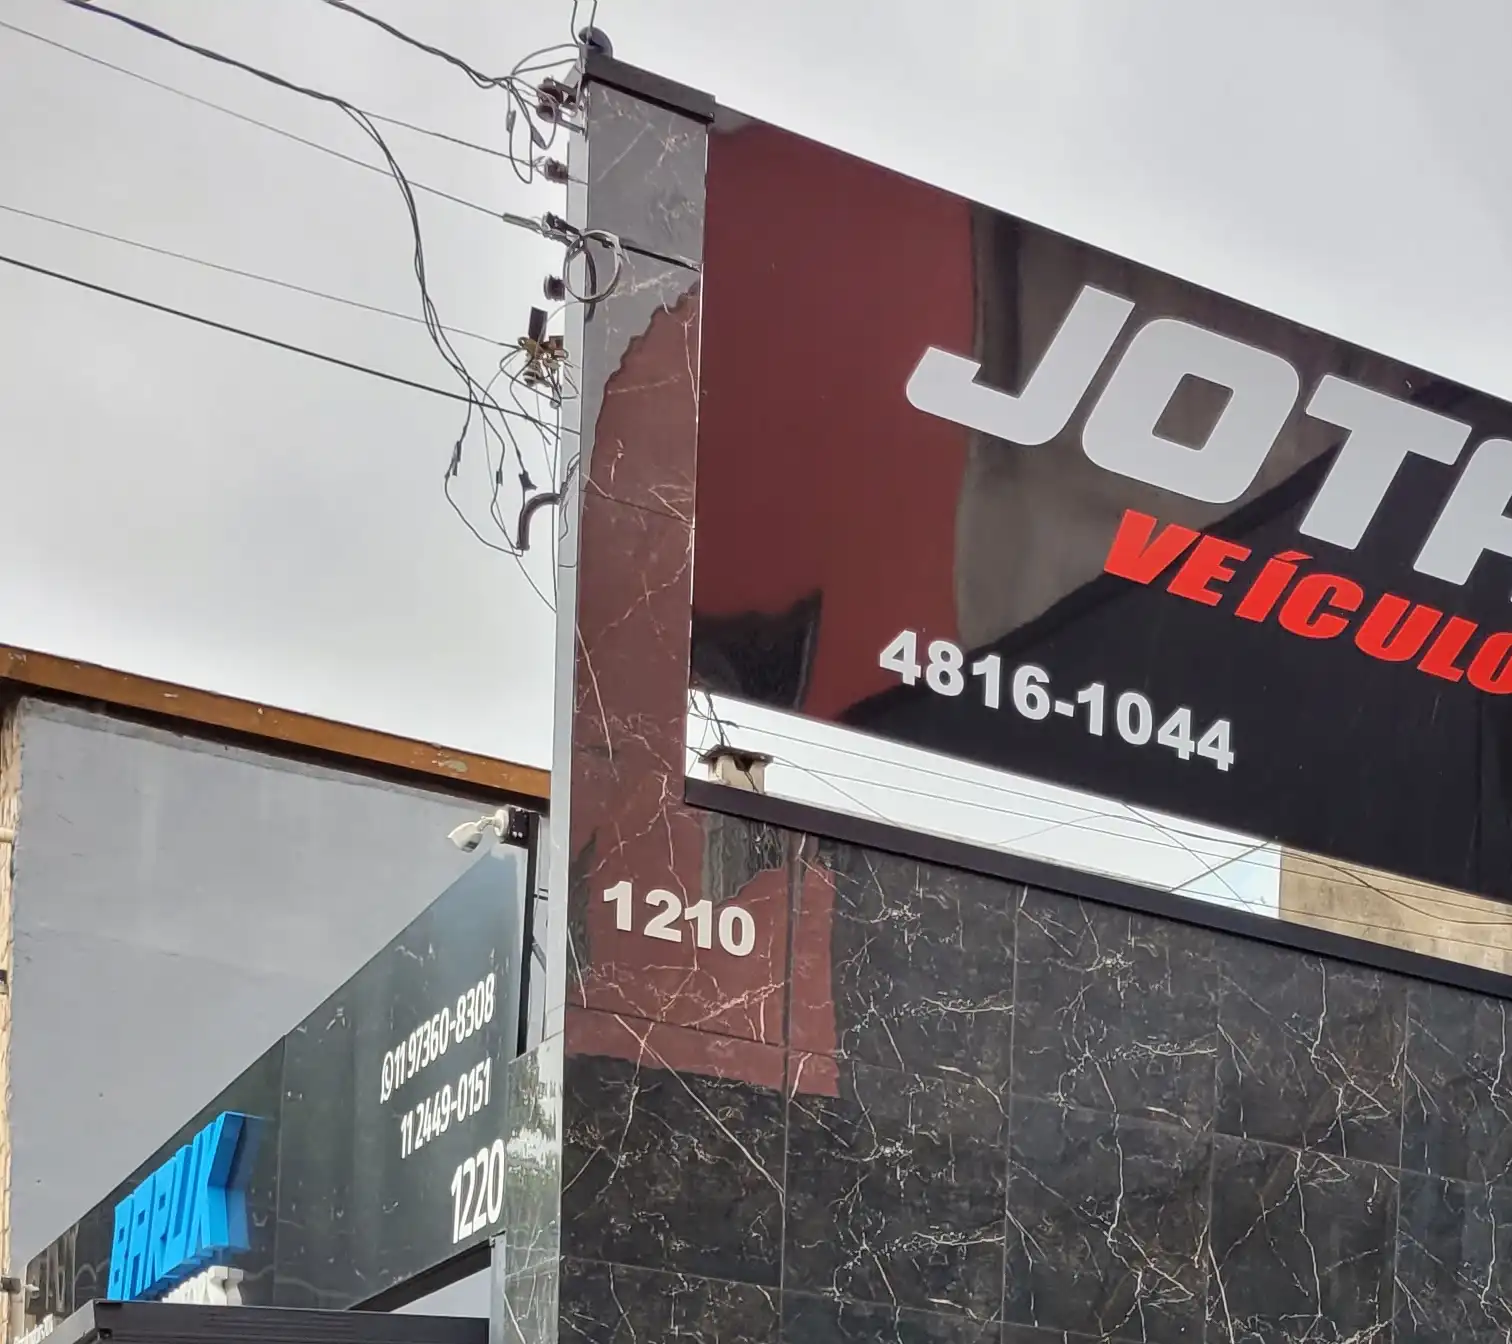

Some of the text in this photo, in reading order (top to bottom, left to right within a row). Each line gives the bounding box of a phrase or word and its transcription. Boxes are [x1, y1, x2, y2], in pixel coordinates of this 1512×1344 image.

[879, 630, 1236, 772] 4816-1044
[603, 880, 756, 956] 1210
[107, 1111, 241, 1301] BARUK
[451, 1138, 505, 1244] 1220
